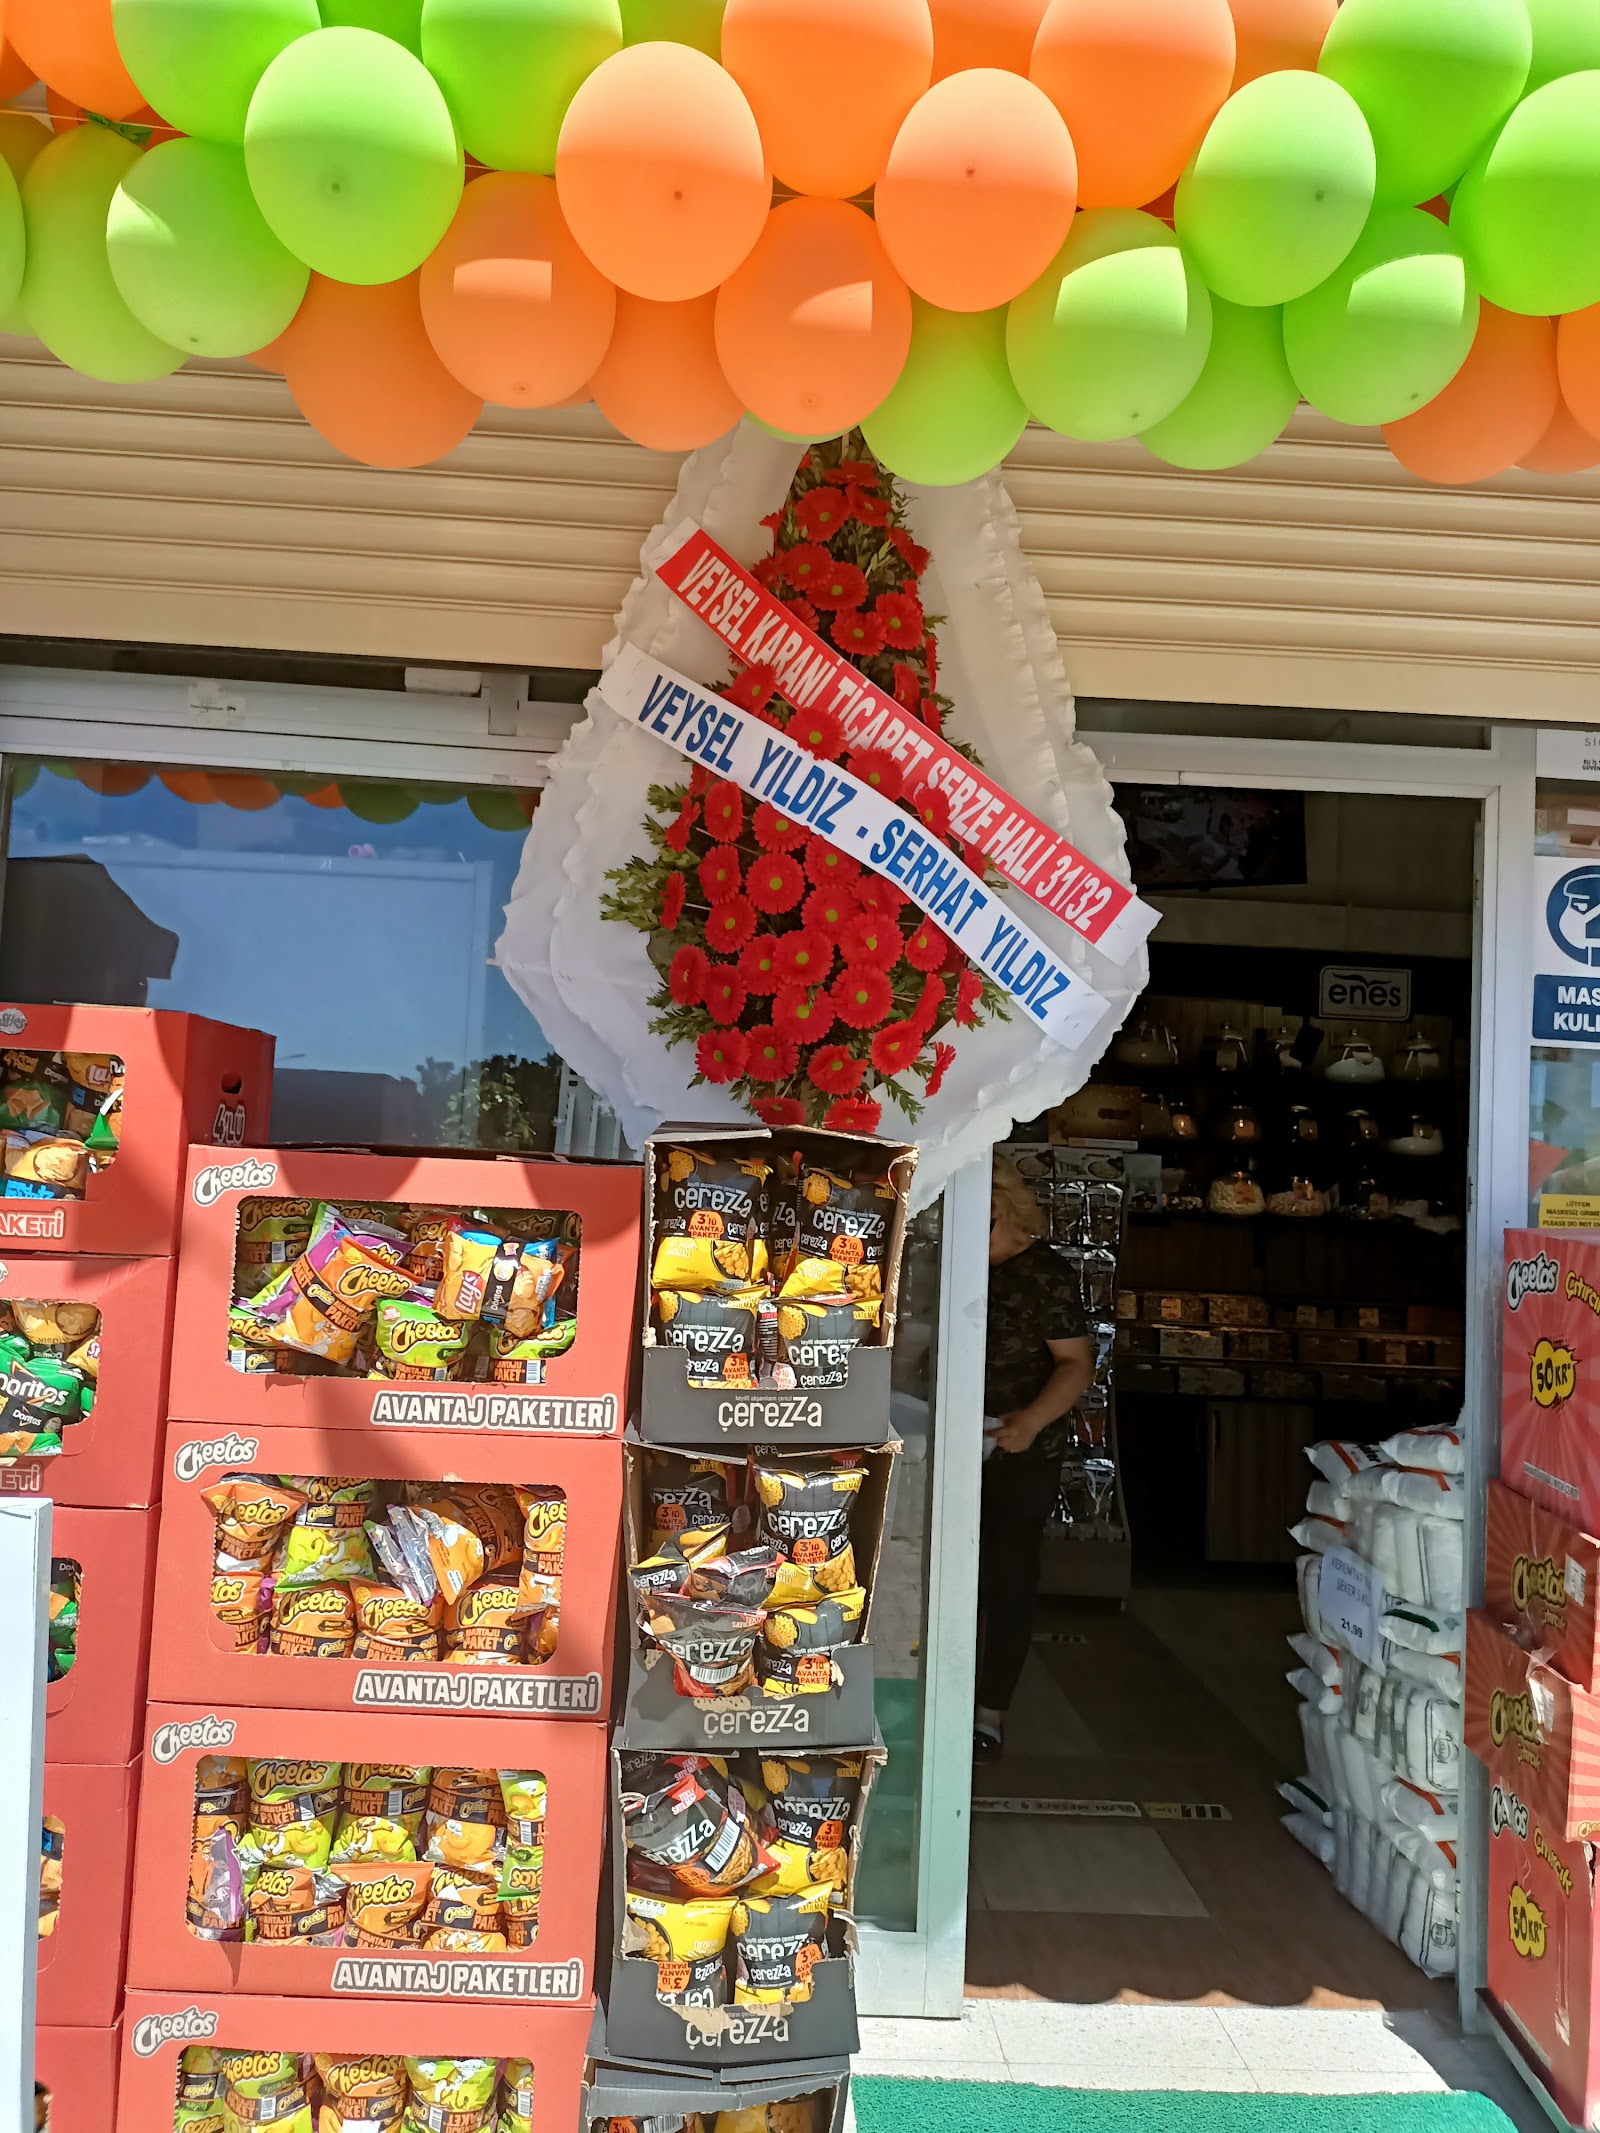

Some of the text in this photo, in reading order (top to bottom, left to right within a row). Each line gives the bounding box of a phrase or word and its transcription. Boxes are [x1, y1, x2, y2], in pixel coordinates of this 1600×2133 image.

[677, 548, 760, 645] VEYSEL
[740, 608, 844, 708] KARANİ
[981, 811, 1064, 886] HALİ
[1034, 854, 1113, 932] 31/32
[638, 675, 745, 774] VEYSEL
[748, 737, 858, 836] YILDIZ
[870, 818, 988, 935] SERHAT
[978, 917, 1072, 1020] YILDIZ
[1328, 981, 1402, 1008] enes
[196, 1160, 276, 1205] Cheetos
[240, 1200, 312, 1232] Cheetos
[674, 1186, 753, 1219] çerezza
[830, 1247, 864, 1258] AVANTAJ
[832, 1254, 859, 1263] PAKETİ
[308, 1285, 335, 1304] Cheetos
[339, 1266, 411, 1297] Cheetos
[455, 1270, 483, 1314] Lay's
[490, 1284, 504, 1311] Doritos
[1507, 1251, 1559, 1312] Cheetos
[390, 1321, 465, 1354] Cheetos
[800, 1370, 843, 1387] çerezza
[1536, 1357, 1553, 1393] 50
[12, 1408, 42, 1427] Doritos
[376, 1396, 613, 1431] AVANTAJ PAKETLERİ
[718, 1396, 823, 1433] çerezza
[177, 1434, 256, 1478] Cheetos
[308, 1505, 335, 1521] Cheetos
[336, 1513, 364, 1526] PAKET
[793, 1549, 827, 1558] AVANTAJ
[633, 1568, 678, 1588] çerezza
[278, 1591, 348, 1627] Cheetos
[279, 1641, 311, 1654] PAKET
[318, 1639, 346, 1657] Cheetos
[463, 1637, 499, 1650] PAKET
[358, 1673, 599, 1709] AVANTAJ PAKETLERİ
[703, 1703, 810, 1740] çerezza
[1490, 1690, 1541, 1748] Cheeto
[154, 1716, 234, 1762] Cheetos
[254, 1762, 329, 1798] Cheetos
[259, 1810, 296, 1825] PAKET
[350, 1801, 383, 1815] PAKET
[350, 1874, 415, 1920] Cheetos
[299, 1911, 326, 1932] Cheetos
[444, 1906, 474, 1922] Cheetos
[1513, 1905, 1527, 1942] 50
[259, 1924, 292, 1938] PAKET
[337, 1962, 579, 1996] AVANTAJ PAKETLERİ
[750, 1964, 792, 1982] çerezza
[135, 2007, 216, 2055] Cheetos
[327, 2055, 399, 2095] Cheetos
